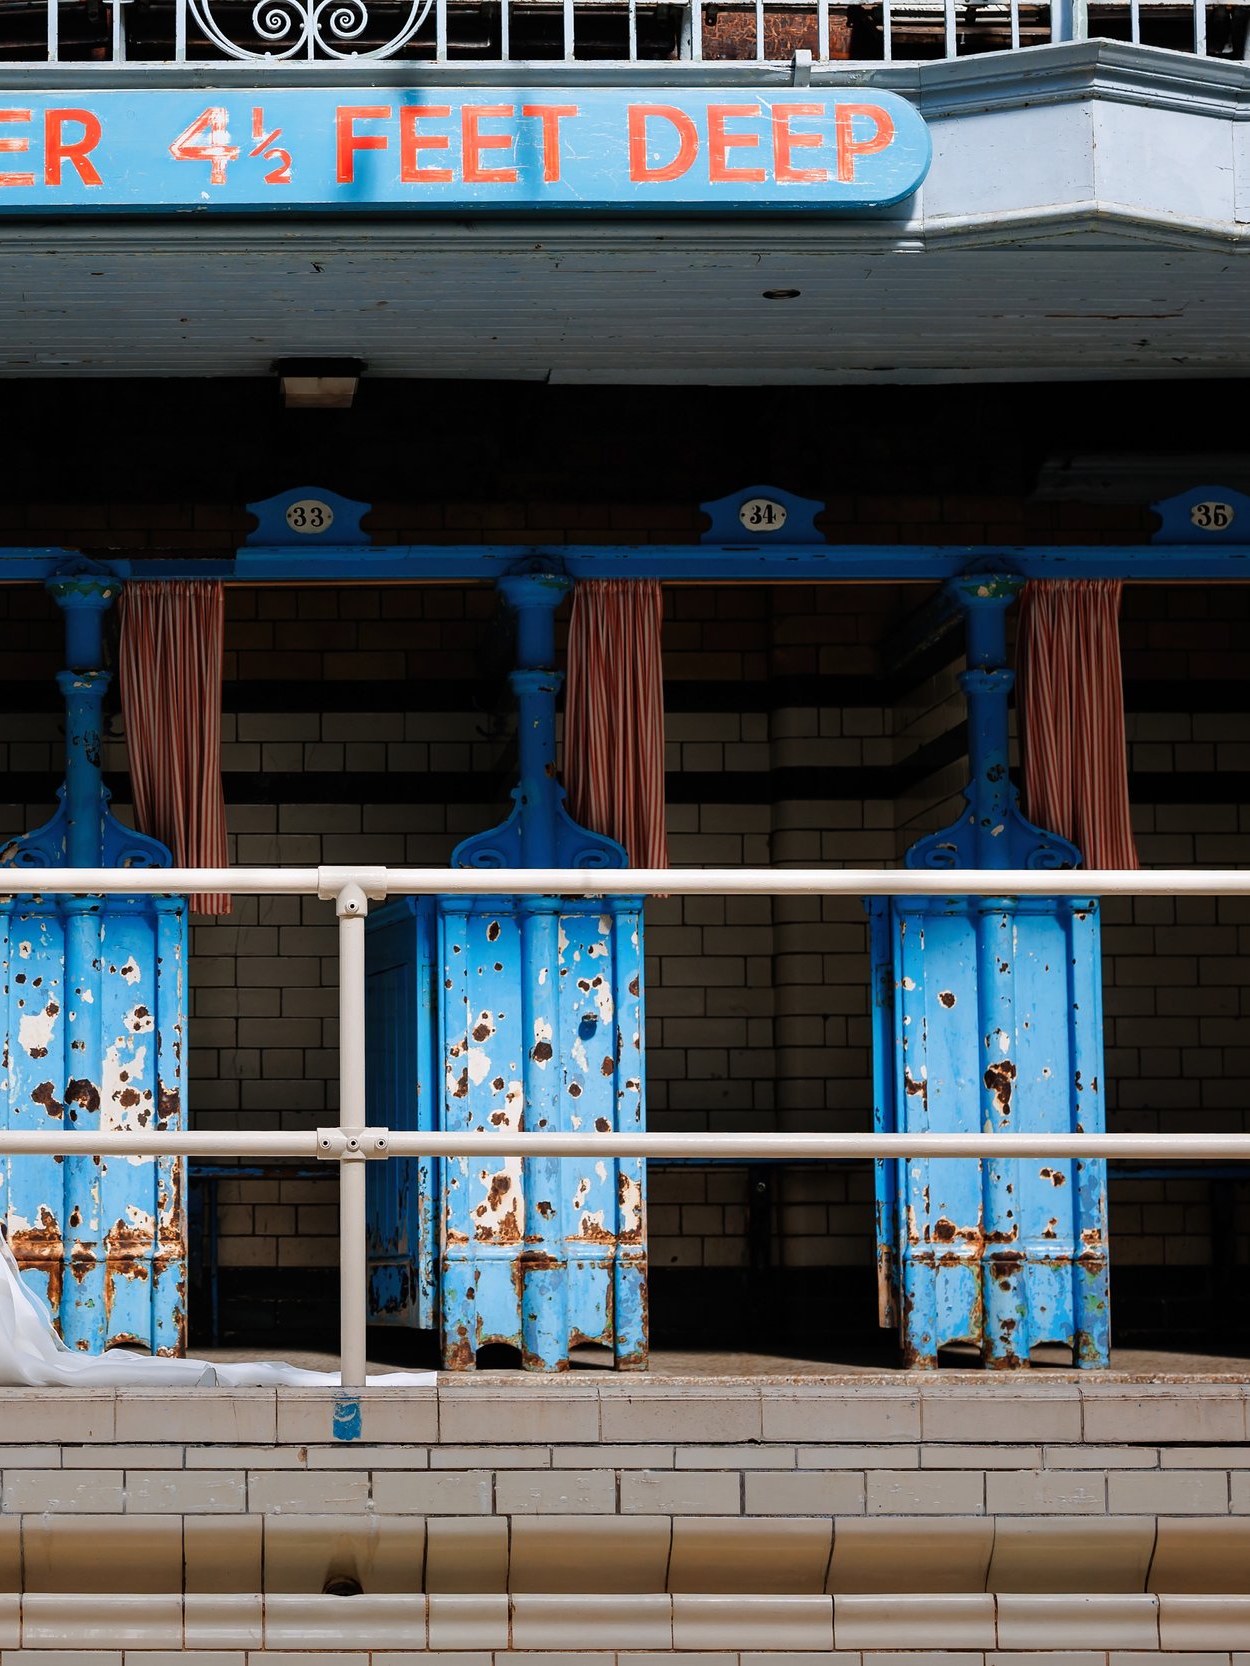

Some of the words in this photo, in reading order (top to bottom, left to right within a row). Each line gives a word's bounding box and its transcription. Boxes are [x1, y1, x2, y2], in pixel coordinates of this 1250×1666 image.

[334, 104, 578, 184] FEET
[626, 103, 896, 183] DEEP
[293, 507, 324, 527] 33
[750, 504, 777, 525] 34
[1197, 504, 1228, 527] 35
